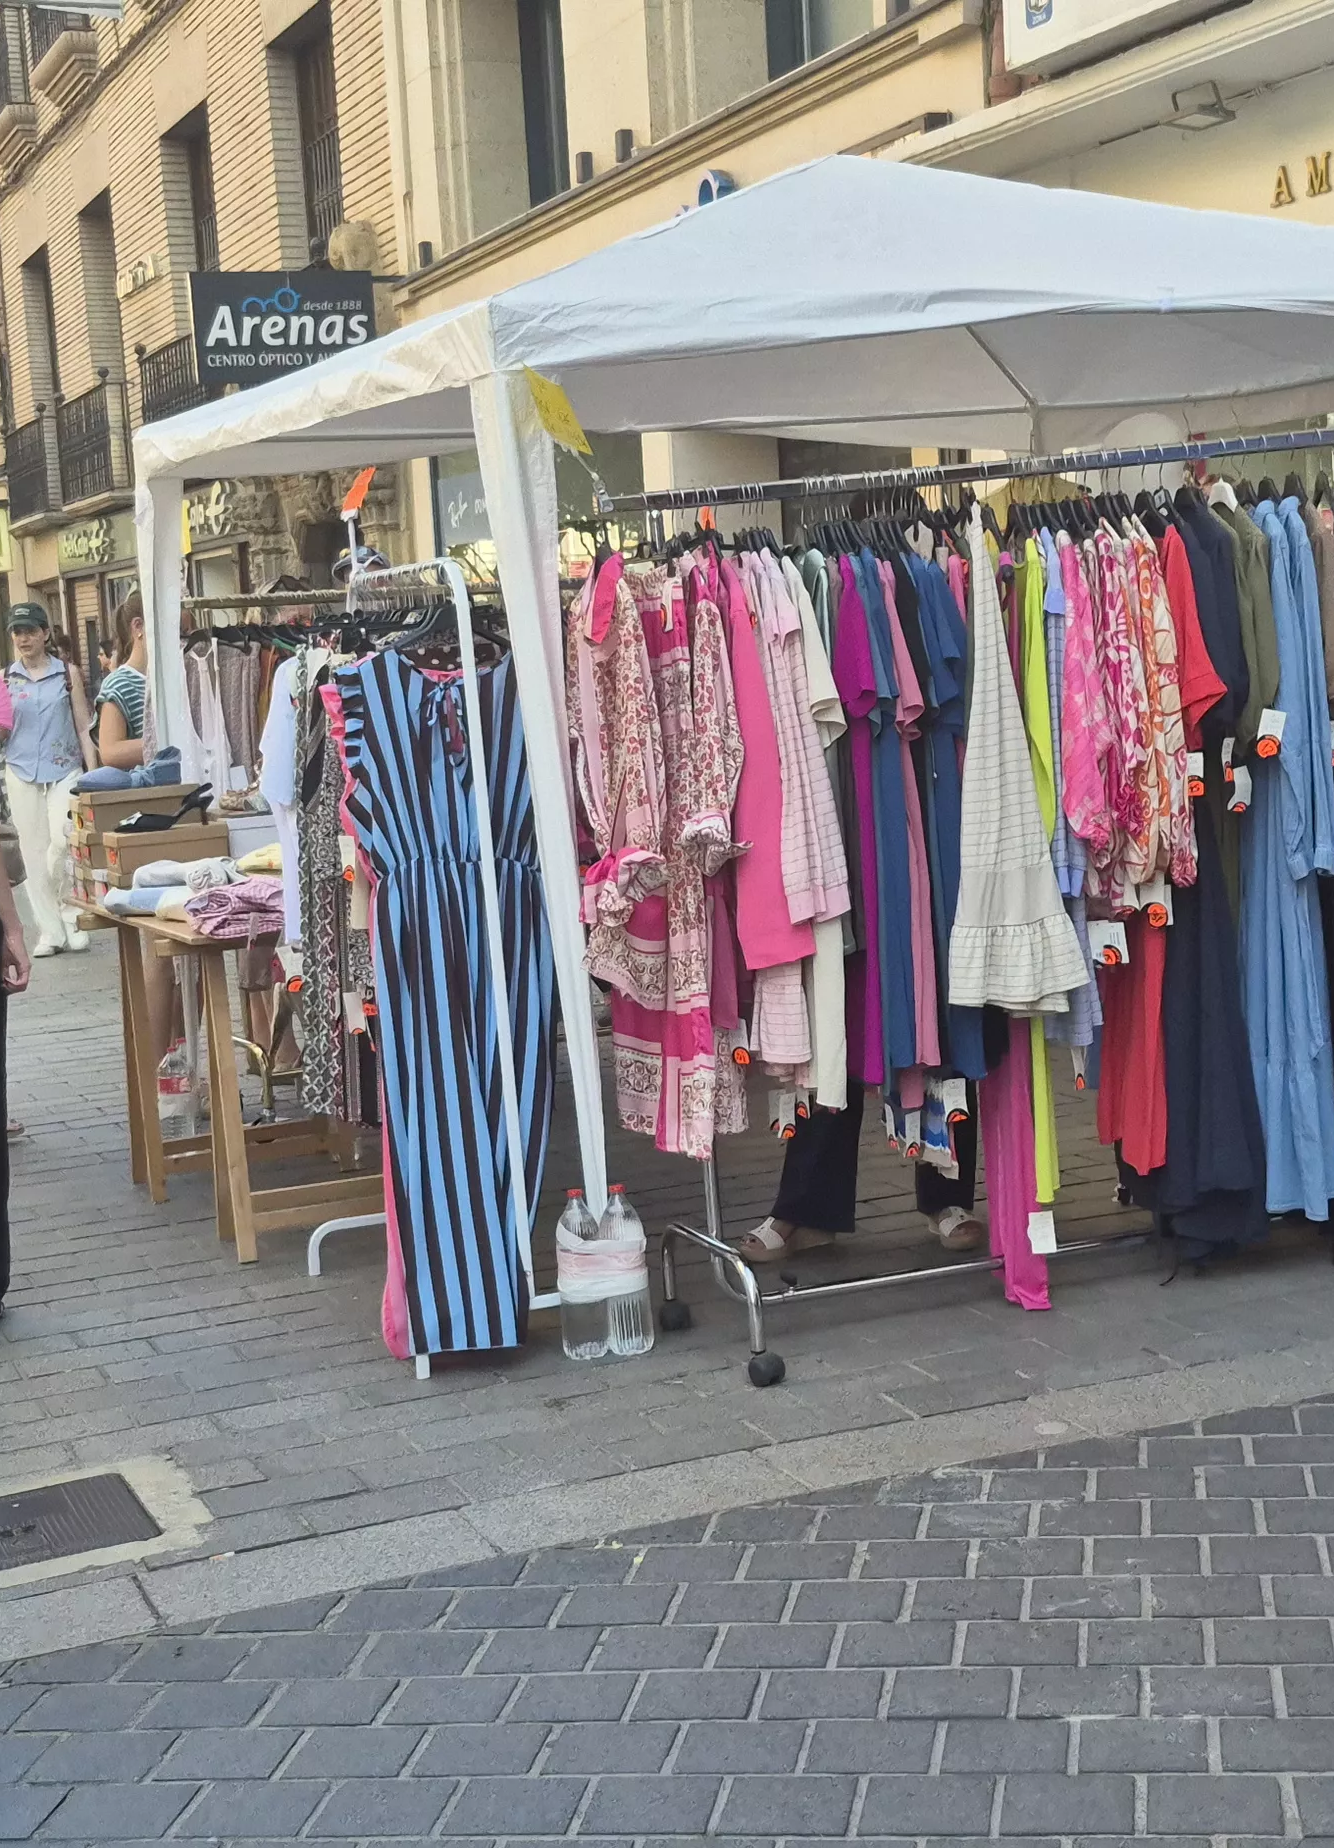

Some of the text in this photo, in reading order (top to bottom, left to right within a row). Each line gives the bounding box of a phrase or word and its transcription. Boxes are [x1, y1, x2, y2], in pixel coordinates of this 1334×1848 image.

[303, 300, 362, 311] desde 1888
[205, 305, 369, 348] Arenas
[207, 353, 256, 367] CENTRO
[259, 350, 304, 367] ÓPTICO
[307, 352, 315, 366] Y
